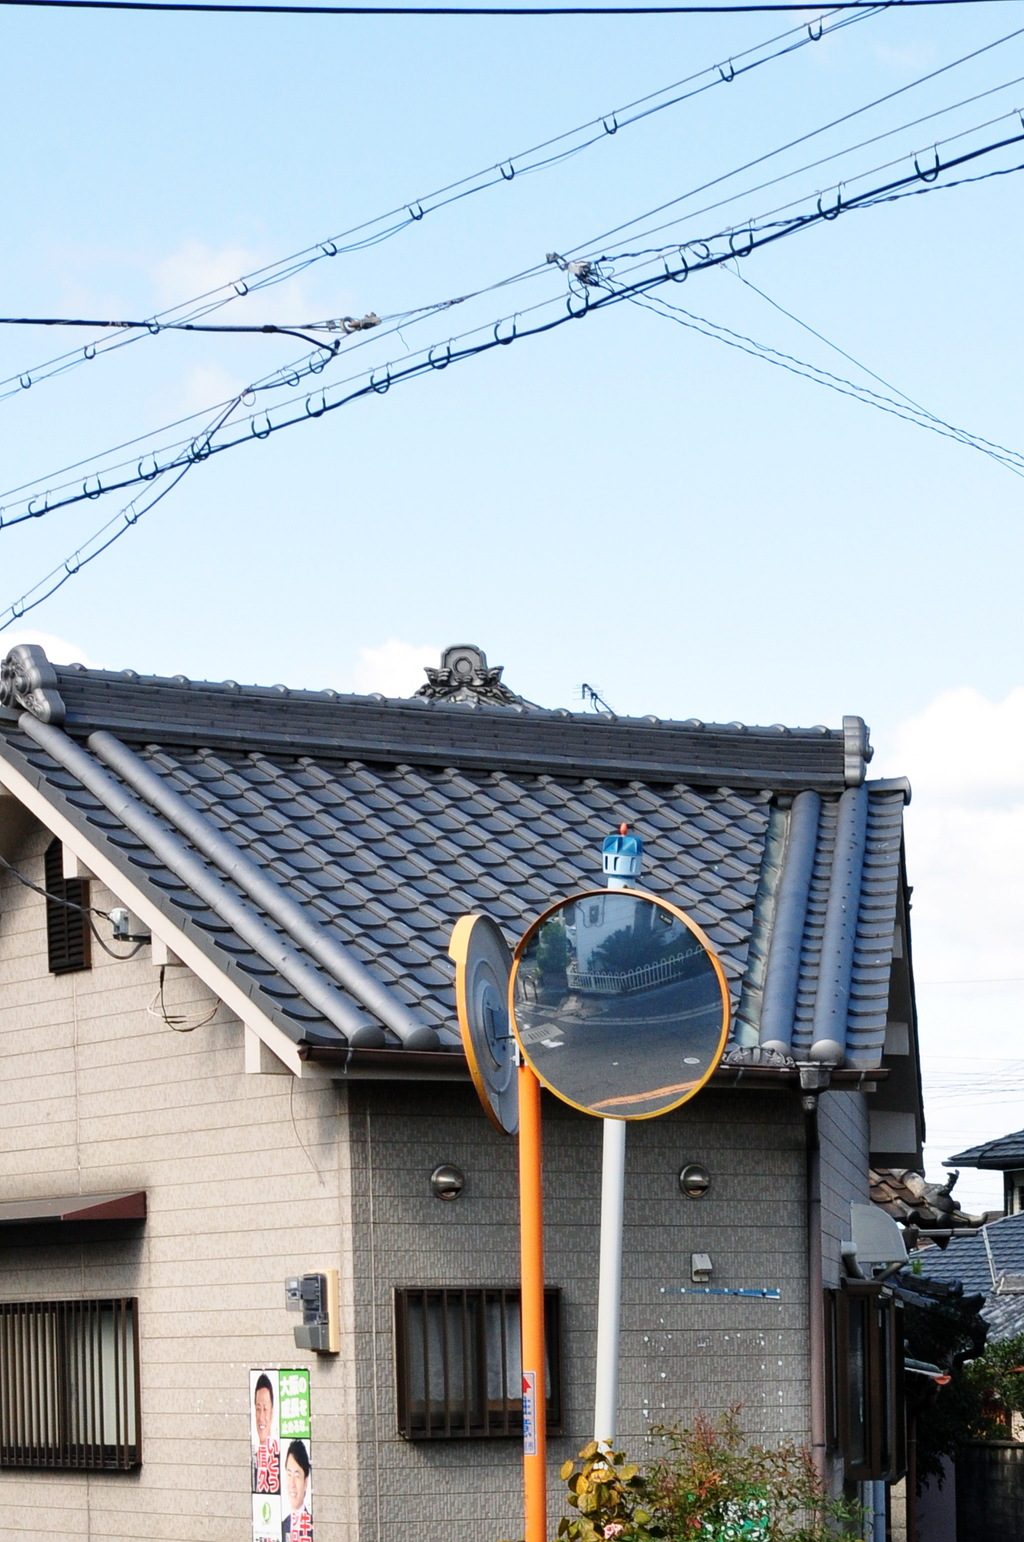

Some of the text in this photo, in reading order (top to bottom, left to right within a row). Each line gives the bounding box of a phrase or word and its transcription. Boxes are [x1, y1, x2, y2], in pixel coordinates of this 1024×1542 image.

[258, 1445, 268, 1491] 信久
[267, 1437, 279, 1491] いとう
